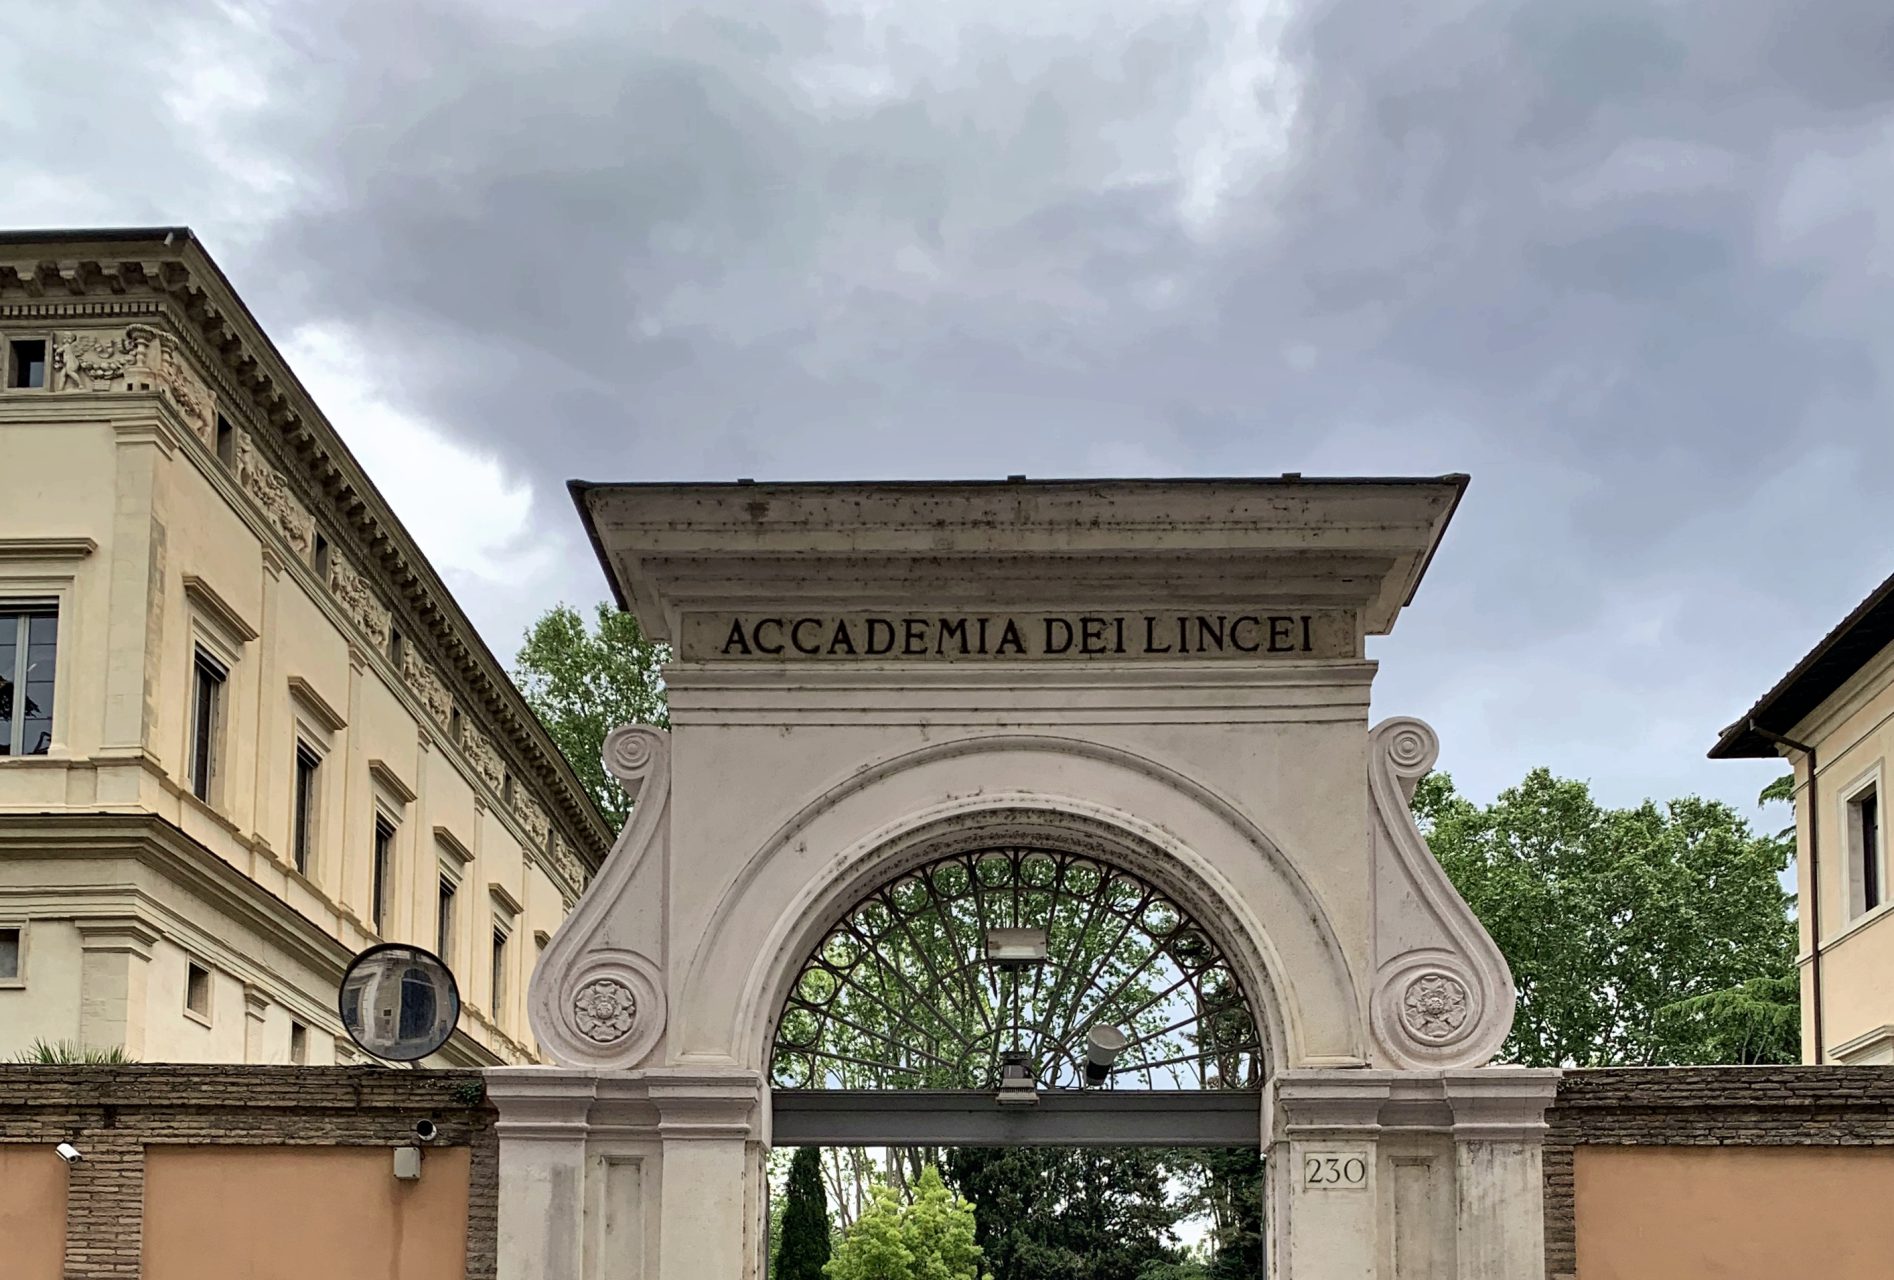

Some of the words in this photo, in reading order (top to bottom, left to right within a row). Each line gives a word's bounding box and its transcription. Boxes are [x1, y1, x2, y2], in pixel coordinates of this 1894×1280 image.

[720, 617, 1028, 655] ACCADEMIA
[1042, 616, 1127, 654] DEI
[1143, 615, 1313, 654] LINCEI
[1306, 1157, 1366, 1184] 230
